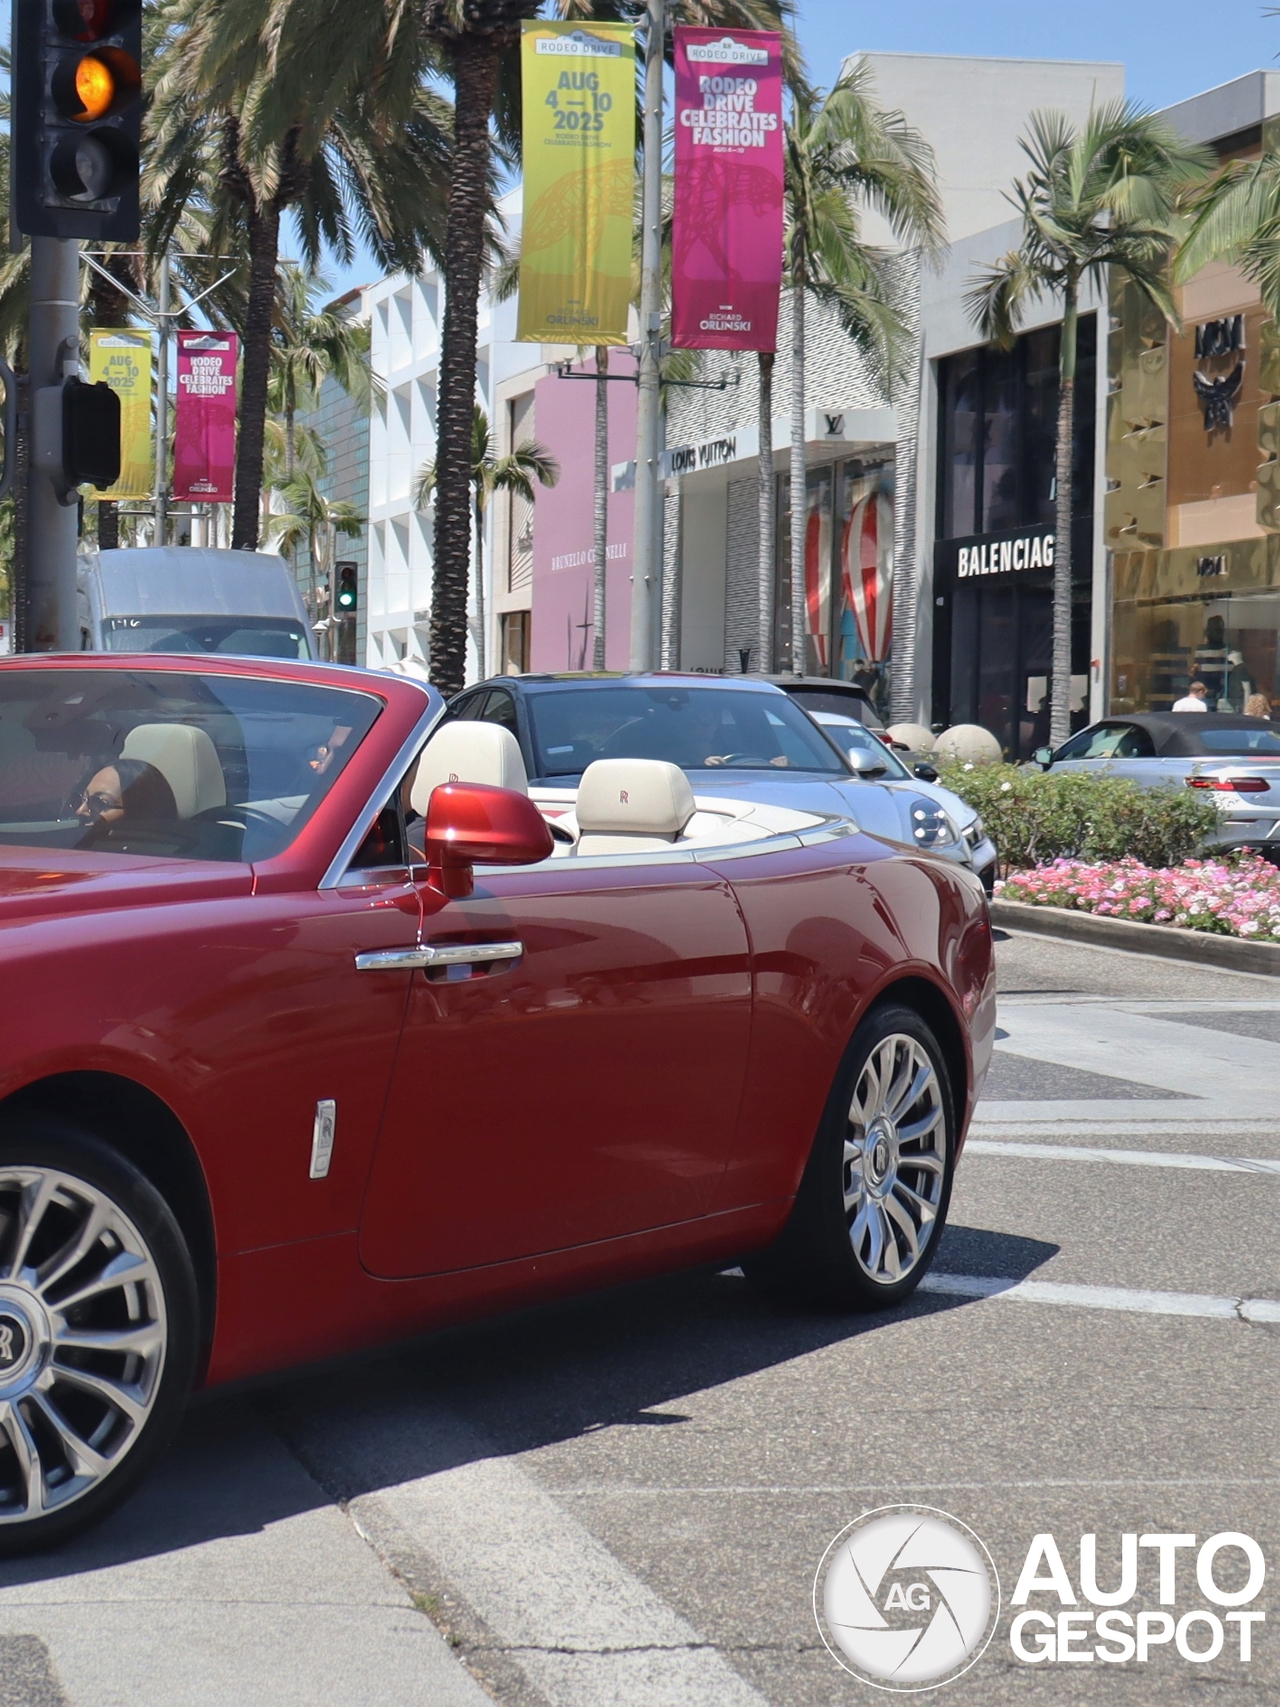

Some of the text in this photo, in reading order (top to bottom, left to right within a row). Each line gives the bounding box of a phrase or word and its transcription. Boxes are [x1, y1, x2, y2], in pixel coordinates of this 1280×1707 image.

[541, 42, 615, 54] RODEO DRIVE
[692, 49, 763, 61] RODEO DRIVE
[557, 71, 600, 91] AUG
[699, 75, 758, 96] RODEO
[544, 90, 559, 109] 4
[591, 92, 613, 112] 10
[703, 93, 754, 113] DRIVE
[552, 110, 605, 132] 2025
[680, 108, 778, 131] CELEBRATES
[692, 127, 765, 148] FASHION
[546, 314, 599, 326] ORLINSKI
[709, 313, 742, 321] RICHARD
[699, 320, 751, 332] ORLINSKI
[108, 355, 132, 366] AUG
[190, 356, 222, 367] RODEO
[102, 366, 109, 376] 4
[127, 366, 139, 377] 10
[192, 366, 220, 376] DRIVE
[107, 376, 135, 388] 2025
[179, 374, 233, 386] CELEBRATES
[186, 384, 226, 395] FASHION
[671, 436, 737, 472] LOUIS VUITTON
[551, 551, 586, 571] BRUNELLO
[958, 534, 1055, 578] BALENCIAG
